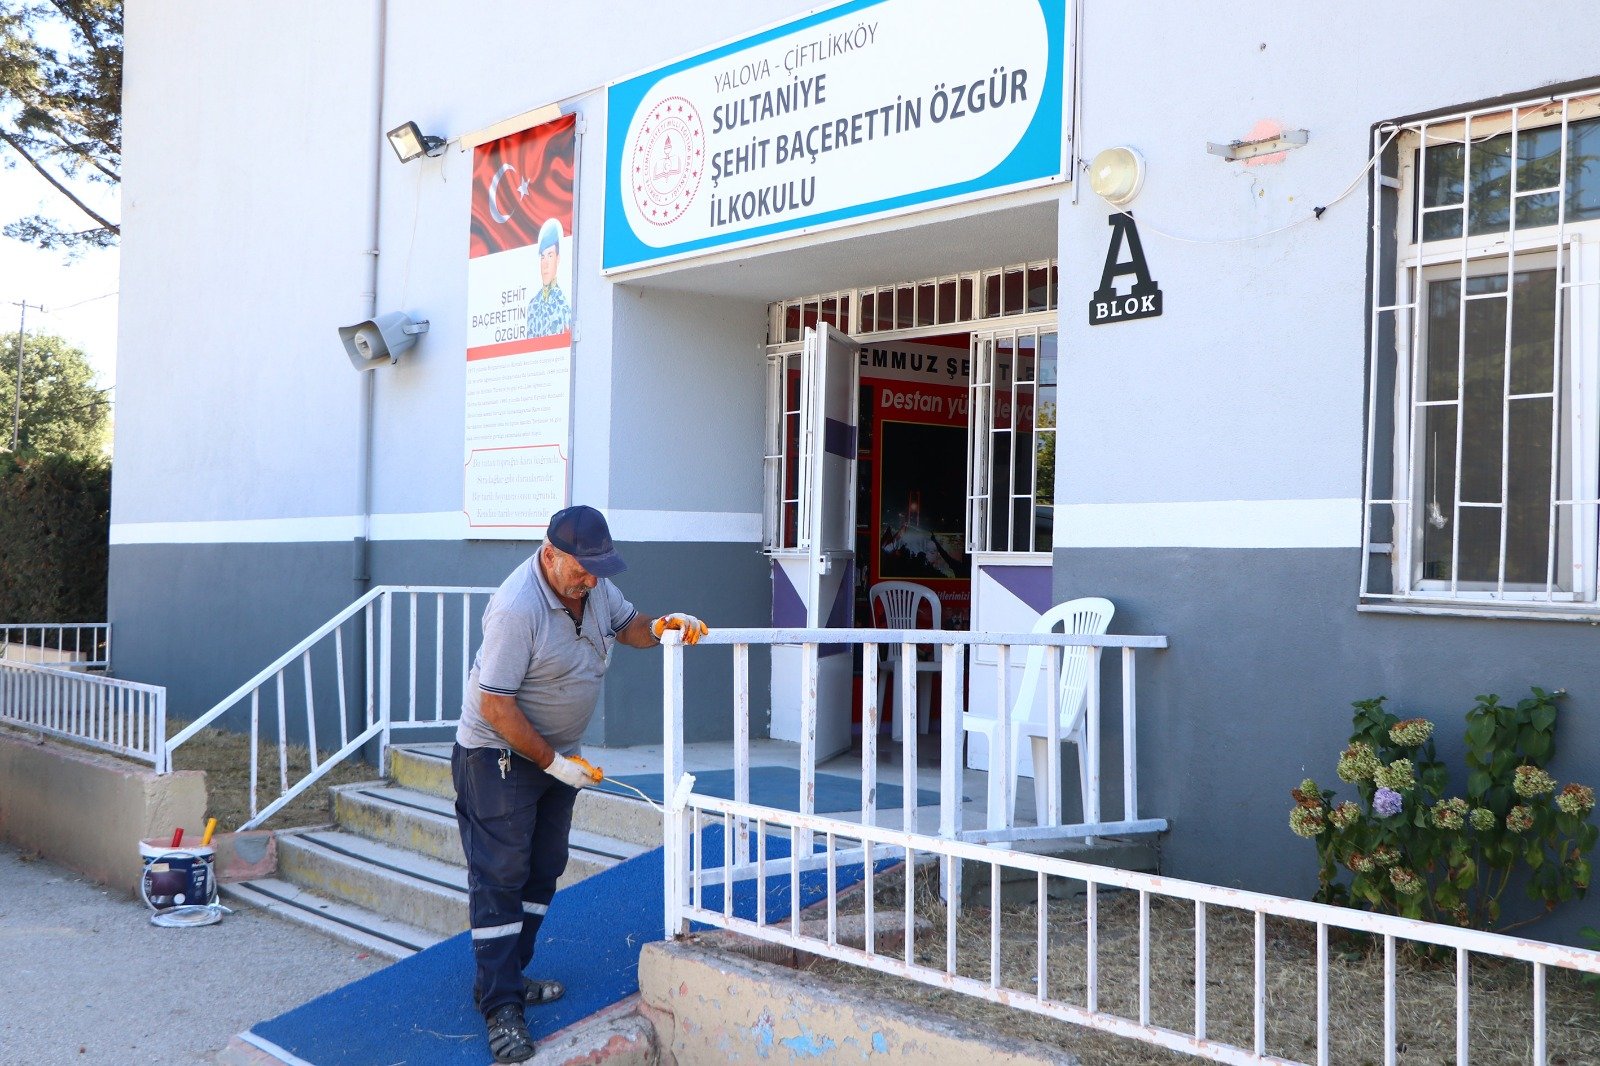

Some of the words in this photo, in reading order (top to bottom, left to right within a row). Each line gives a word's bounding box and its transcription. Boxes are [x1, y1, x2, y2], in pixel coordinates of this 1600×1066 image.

[713, 60, 771, 94] YALOVA
[784, 21, 879, 78] ÇİFTLİKKÖY
[712, 73, 827, 134] SULTANİYE
[711, 136, 768, 186] ŞEHİT
[776, 95, 922, 165] BAÇERETTİN
[929, 66, 1028, 124] ÖZGÜR
[710, 176, 816, 228] İLKOKULU
[1093, 210, 1158, 299] A
[501, 288, 527, 305] ŞEHİT
[1095, 294, 1156, 320] BLOK
[472, 306, 526, 329] BAÇERETTİN
[495, 326, 526, 343] ÖZGÜR
[860, 347, 938, 374] EMMUZ
[881, 388, 943, 413] Destan
